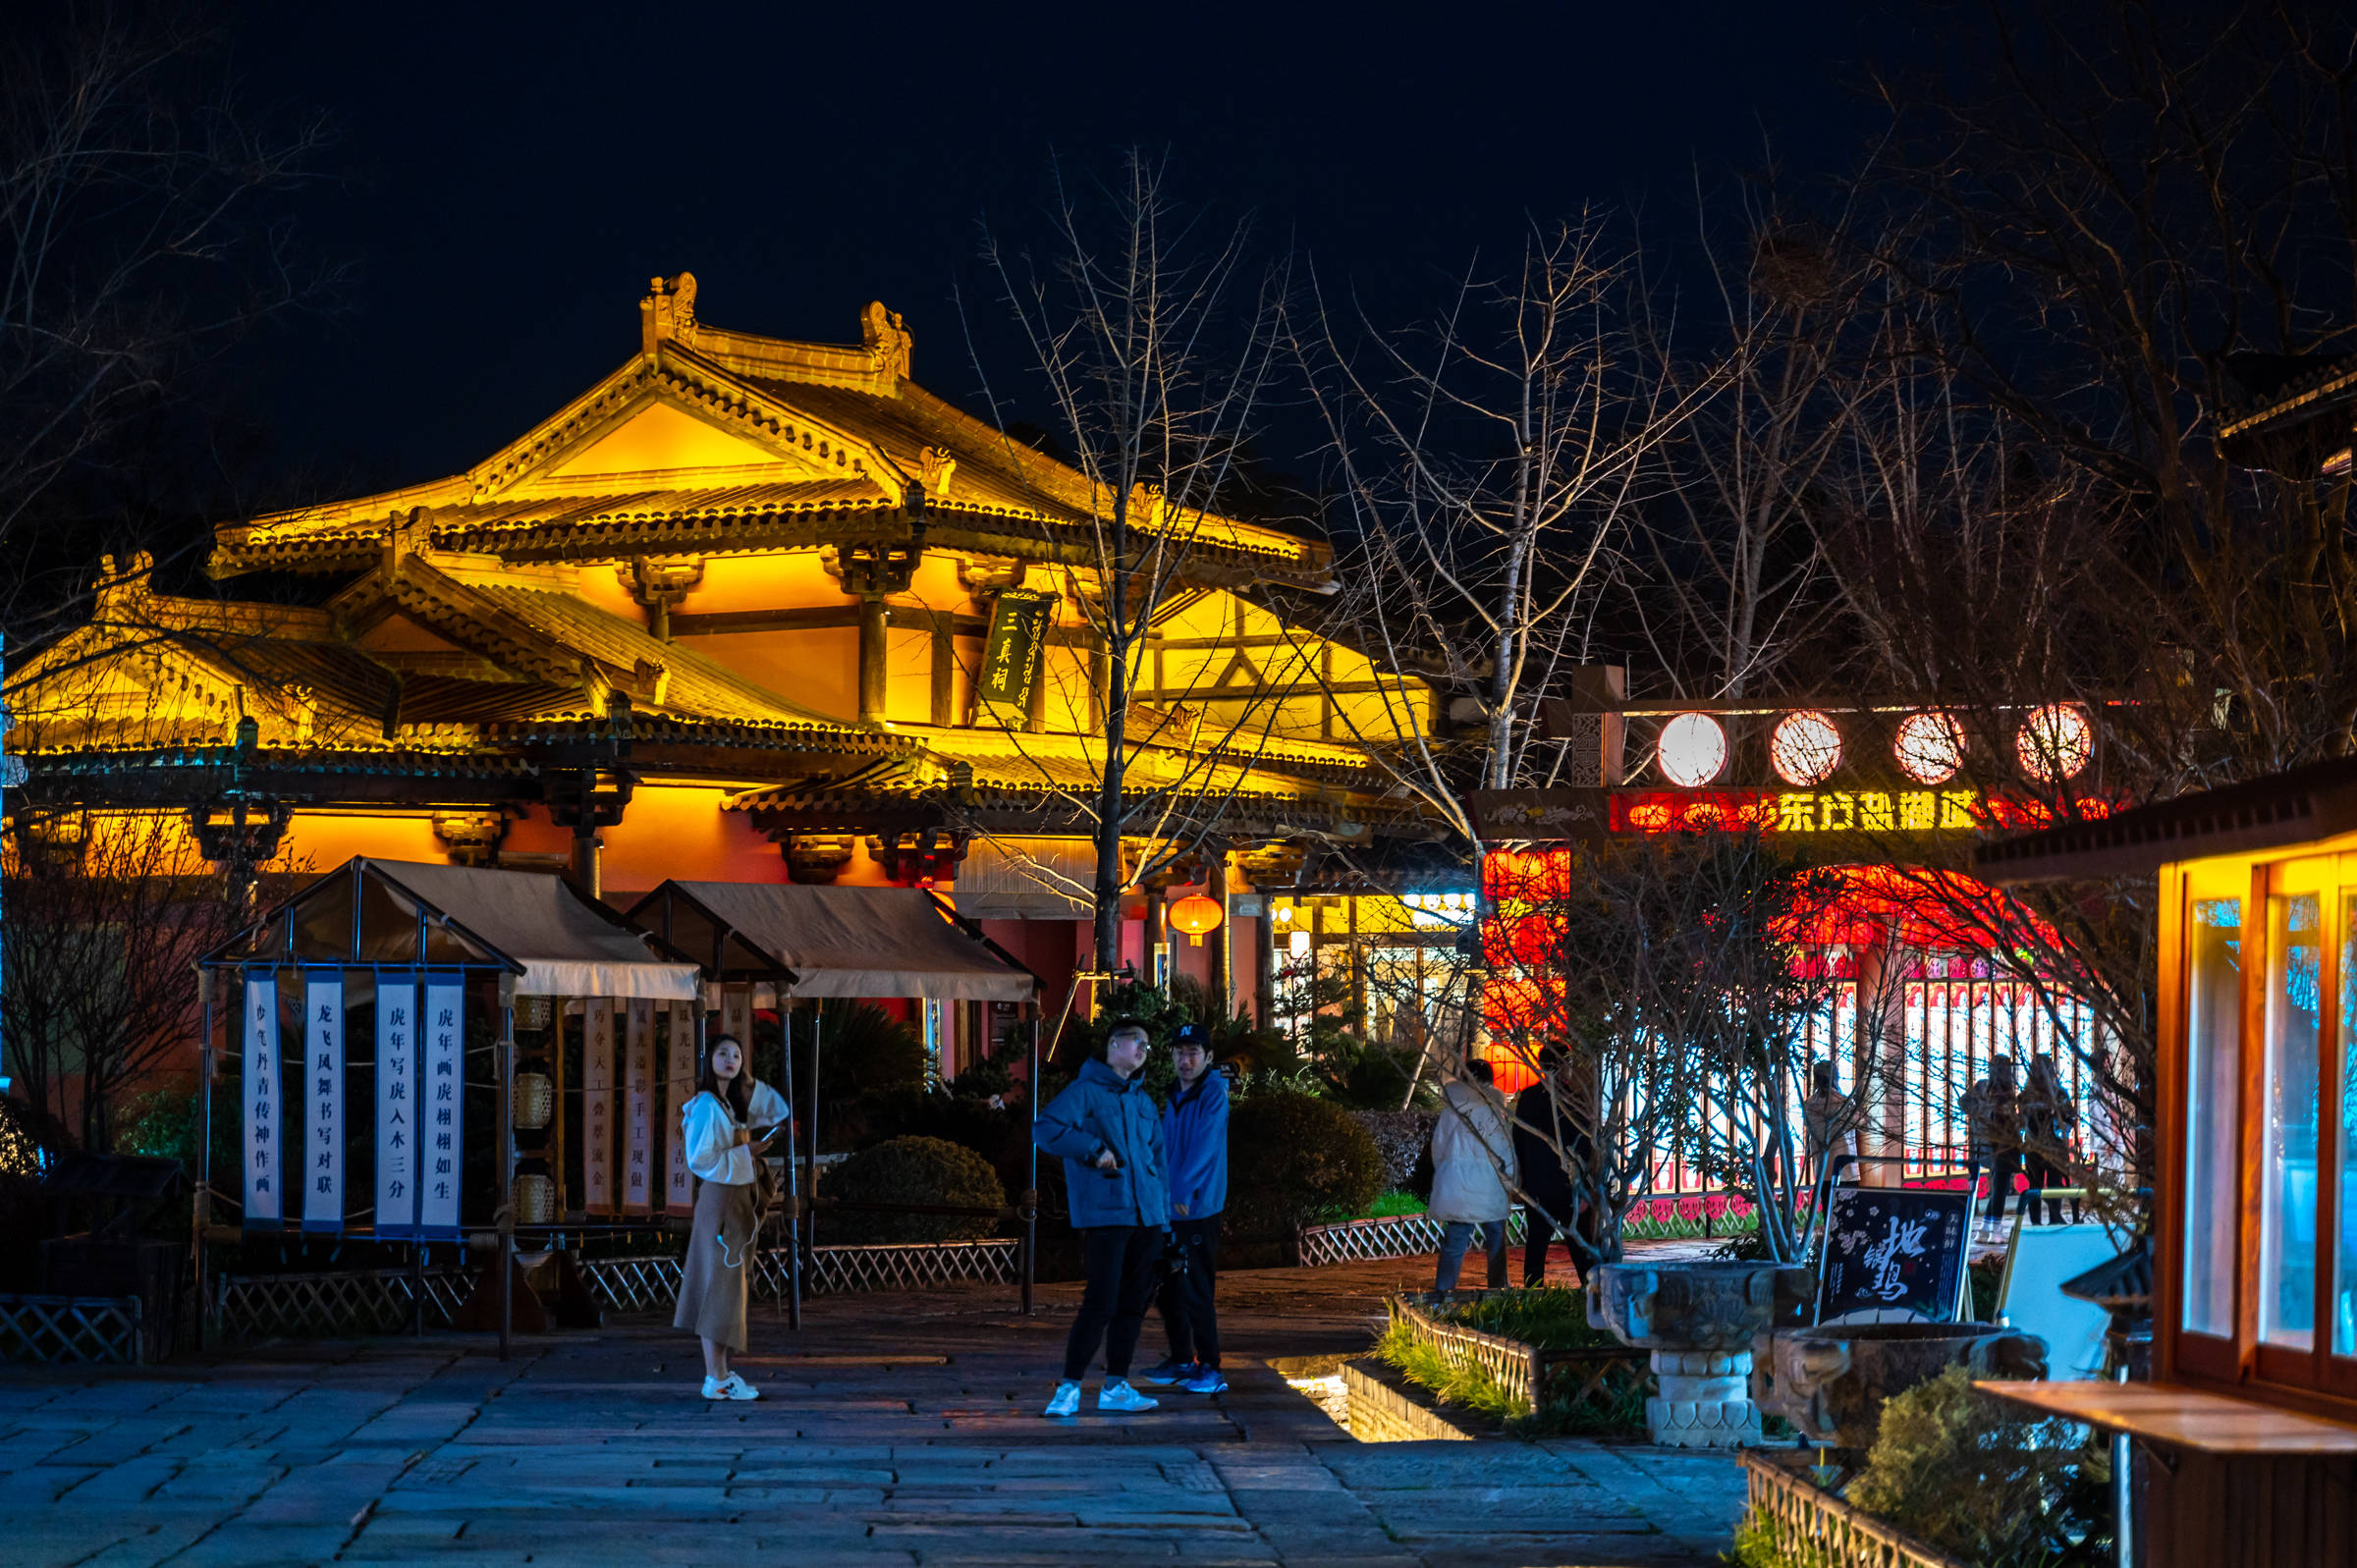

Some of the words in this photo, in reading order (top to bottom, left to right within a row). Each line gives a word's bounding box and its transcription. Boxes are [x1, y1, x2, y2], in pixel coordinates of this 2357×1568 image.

[317, 1004, 332, 1194] 龙飞凤舞书写对联
[389, 1007, 406, 1199] 虎年写虎入木三分
[433, 1008, 453, 1200] 虎年画虎栩栩如生
